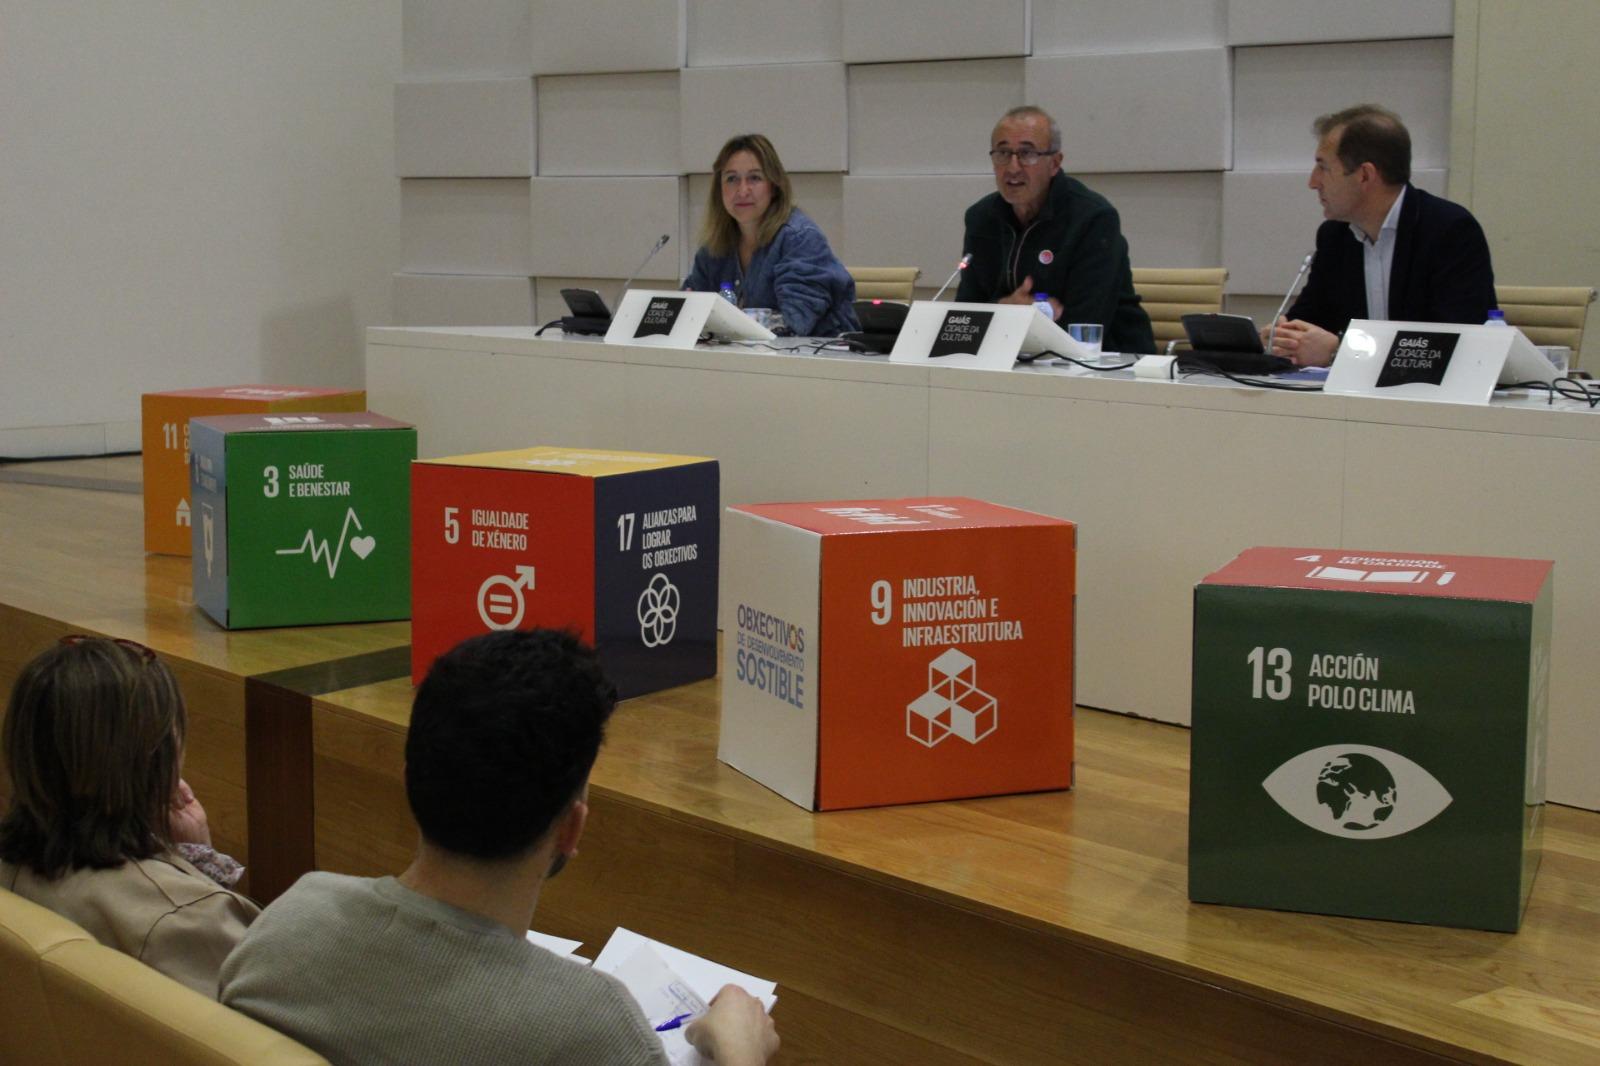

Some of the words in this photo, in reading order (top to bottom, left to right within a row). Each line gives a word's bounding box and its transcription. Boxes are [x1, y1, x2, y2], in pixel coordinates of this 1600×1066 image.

[944, 325, 969, 333] CIDADE
[969, 326, 980, 334] DA
[948, 315, 971, 325] GAIÁS
[941, 333, 973, 342] CULTURA
[1399, 337, 1429, 348] GAIÁS
[1391, 358, 1432, 369] CULTURA
[1395, 348, 1427, 358] CIDADE
[1427, 350, 1441, 359] DA
[162, 423, 178, 450] 11
[263, 465, 280, 498] 3
[289, 463, 325, 480] SAÚDE
[289, 483, 296, 498] E
[296, 481, 350, 497] BENESTAR
[445, 507, 460, 544] 5
[472, 508, 529, 530] IGUALDADE
[642, 508, 678, 530] ALIANZAS
[677, 505, 697, 523] PARA
[472, 530, 485, 547] DE
[486, 531, 528, 551] XÉNERO
[617, 513, 635, 551] 17
[642, 529, 671, 550] LOGRAR
[642, 552, 653, 570] OS
[654, 543, 698, 567] OBXECTIVOS
[903, 575, 980, 598] INDUSTRIA,
[870, 580, 892, 625] 9
[903, 597, 987, 623] INNOVACIÓN
[991, 598, 999, 618] E
[737, 604, 805, 653] OBXECTIVOS
[903, 621, 1023, 647] INFRAESTRUTURA
[737, 648, 804, 709] SOSTIBLE
[1246, 646, 1292, 700] 13
[1309, 653, 1379, 681] ACCIÓN
[1308, 684, 1357, 711] POLO
[1358, 689, 1416, 715] CLIMA
